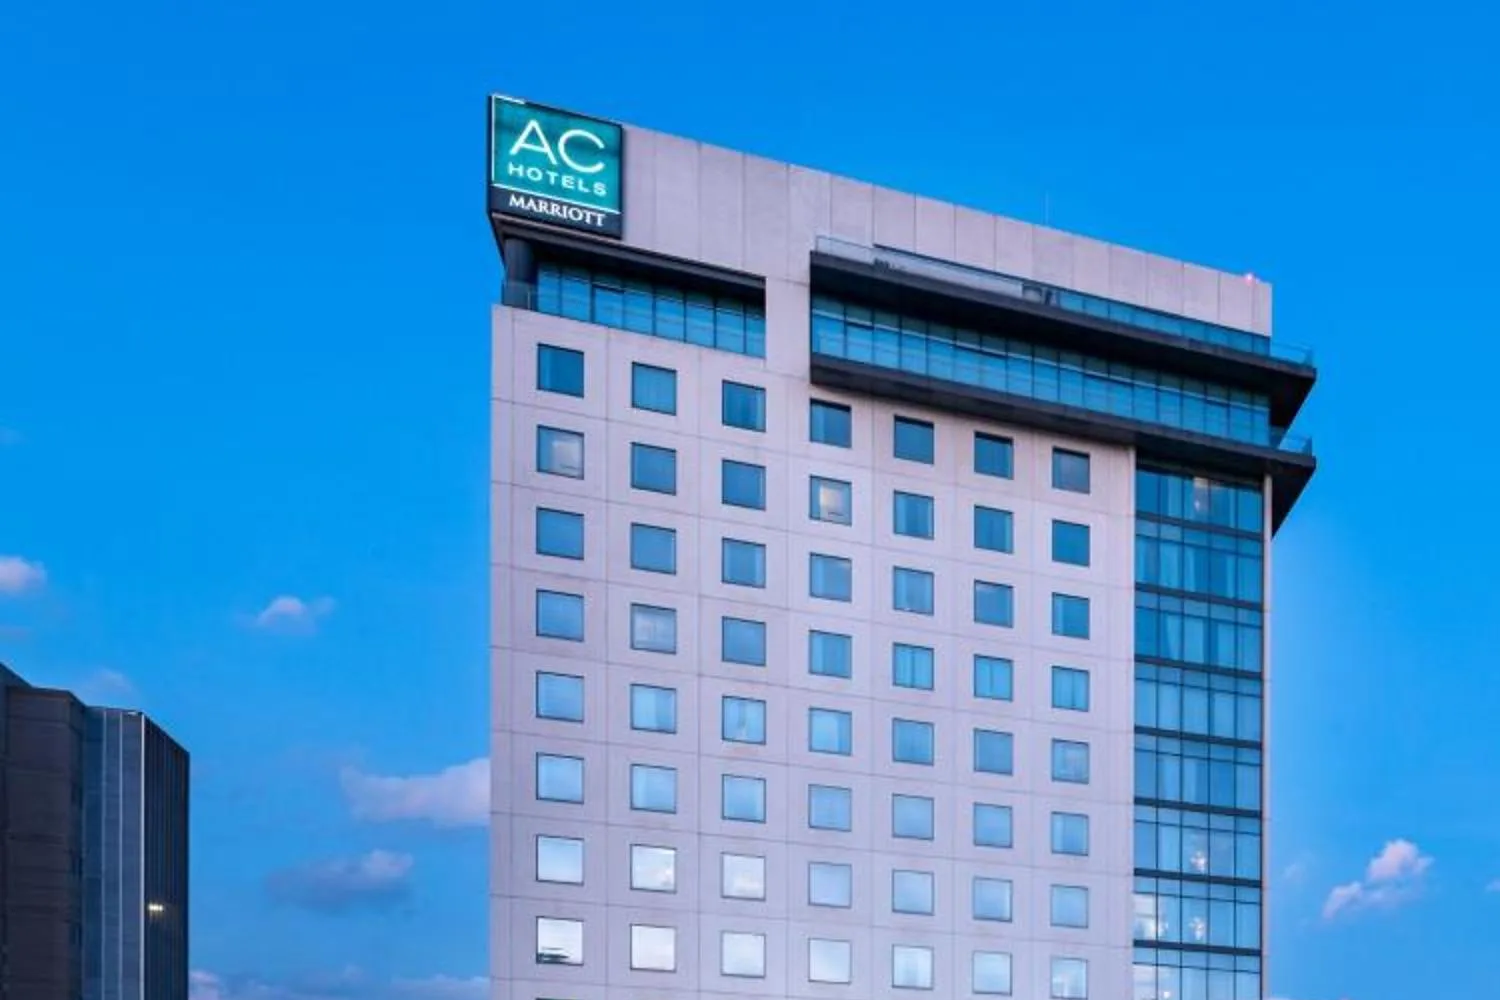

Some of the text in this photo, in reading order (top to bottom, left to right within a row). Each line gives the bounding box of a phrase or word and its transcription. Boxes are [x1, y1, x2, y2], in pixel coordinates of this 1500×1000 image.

[509, 119, 605, 173] AC
[507, 162, 608, 197] HOTELS
[509, 194, 607, 227] MARRIOTT
